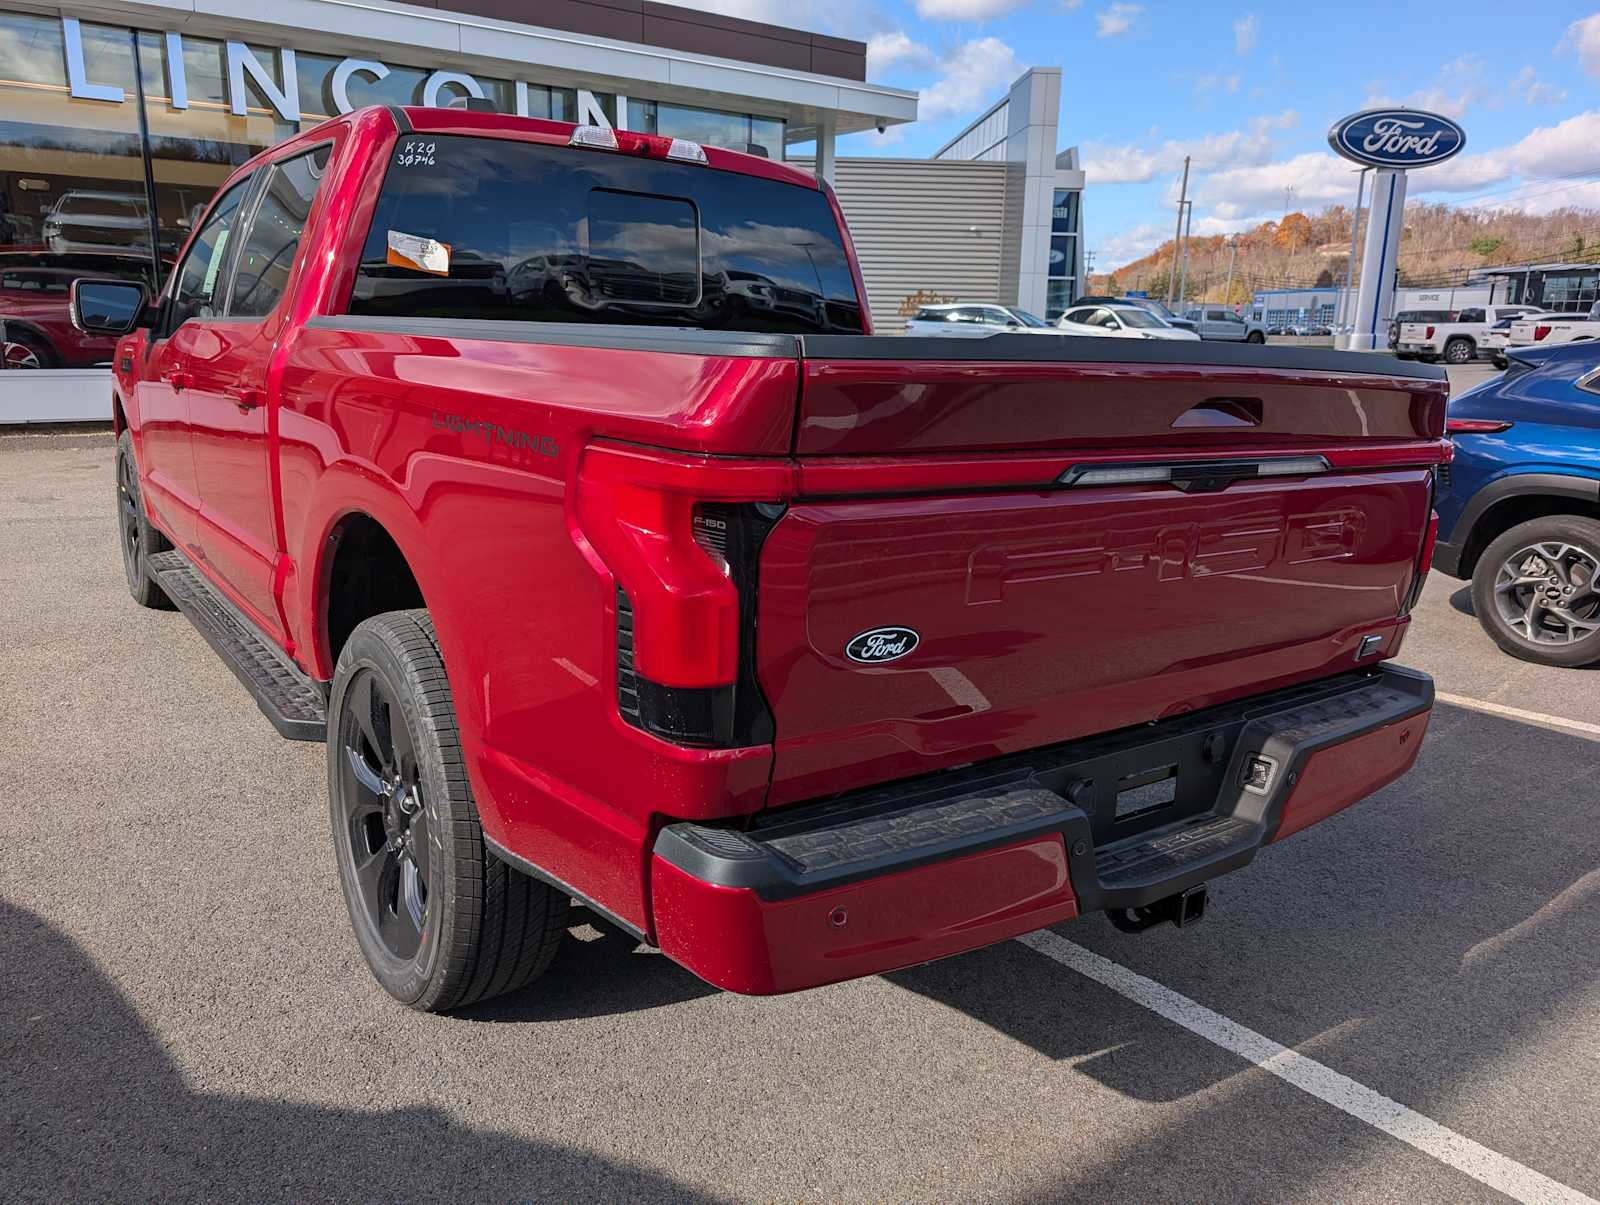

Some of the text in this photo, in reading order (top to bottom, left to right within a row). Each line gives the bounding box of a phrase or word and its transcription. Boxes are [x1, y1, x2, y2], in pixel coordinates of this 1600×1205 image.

[1363, 118, 1442, 155] Ford
[431, 410, 560, 457] LIGHTNING
[694, 516, 727, 530] F-150
[861, 633, 907, 658] Ford
